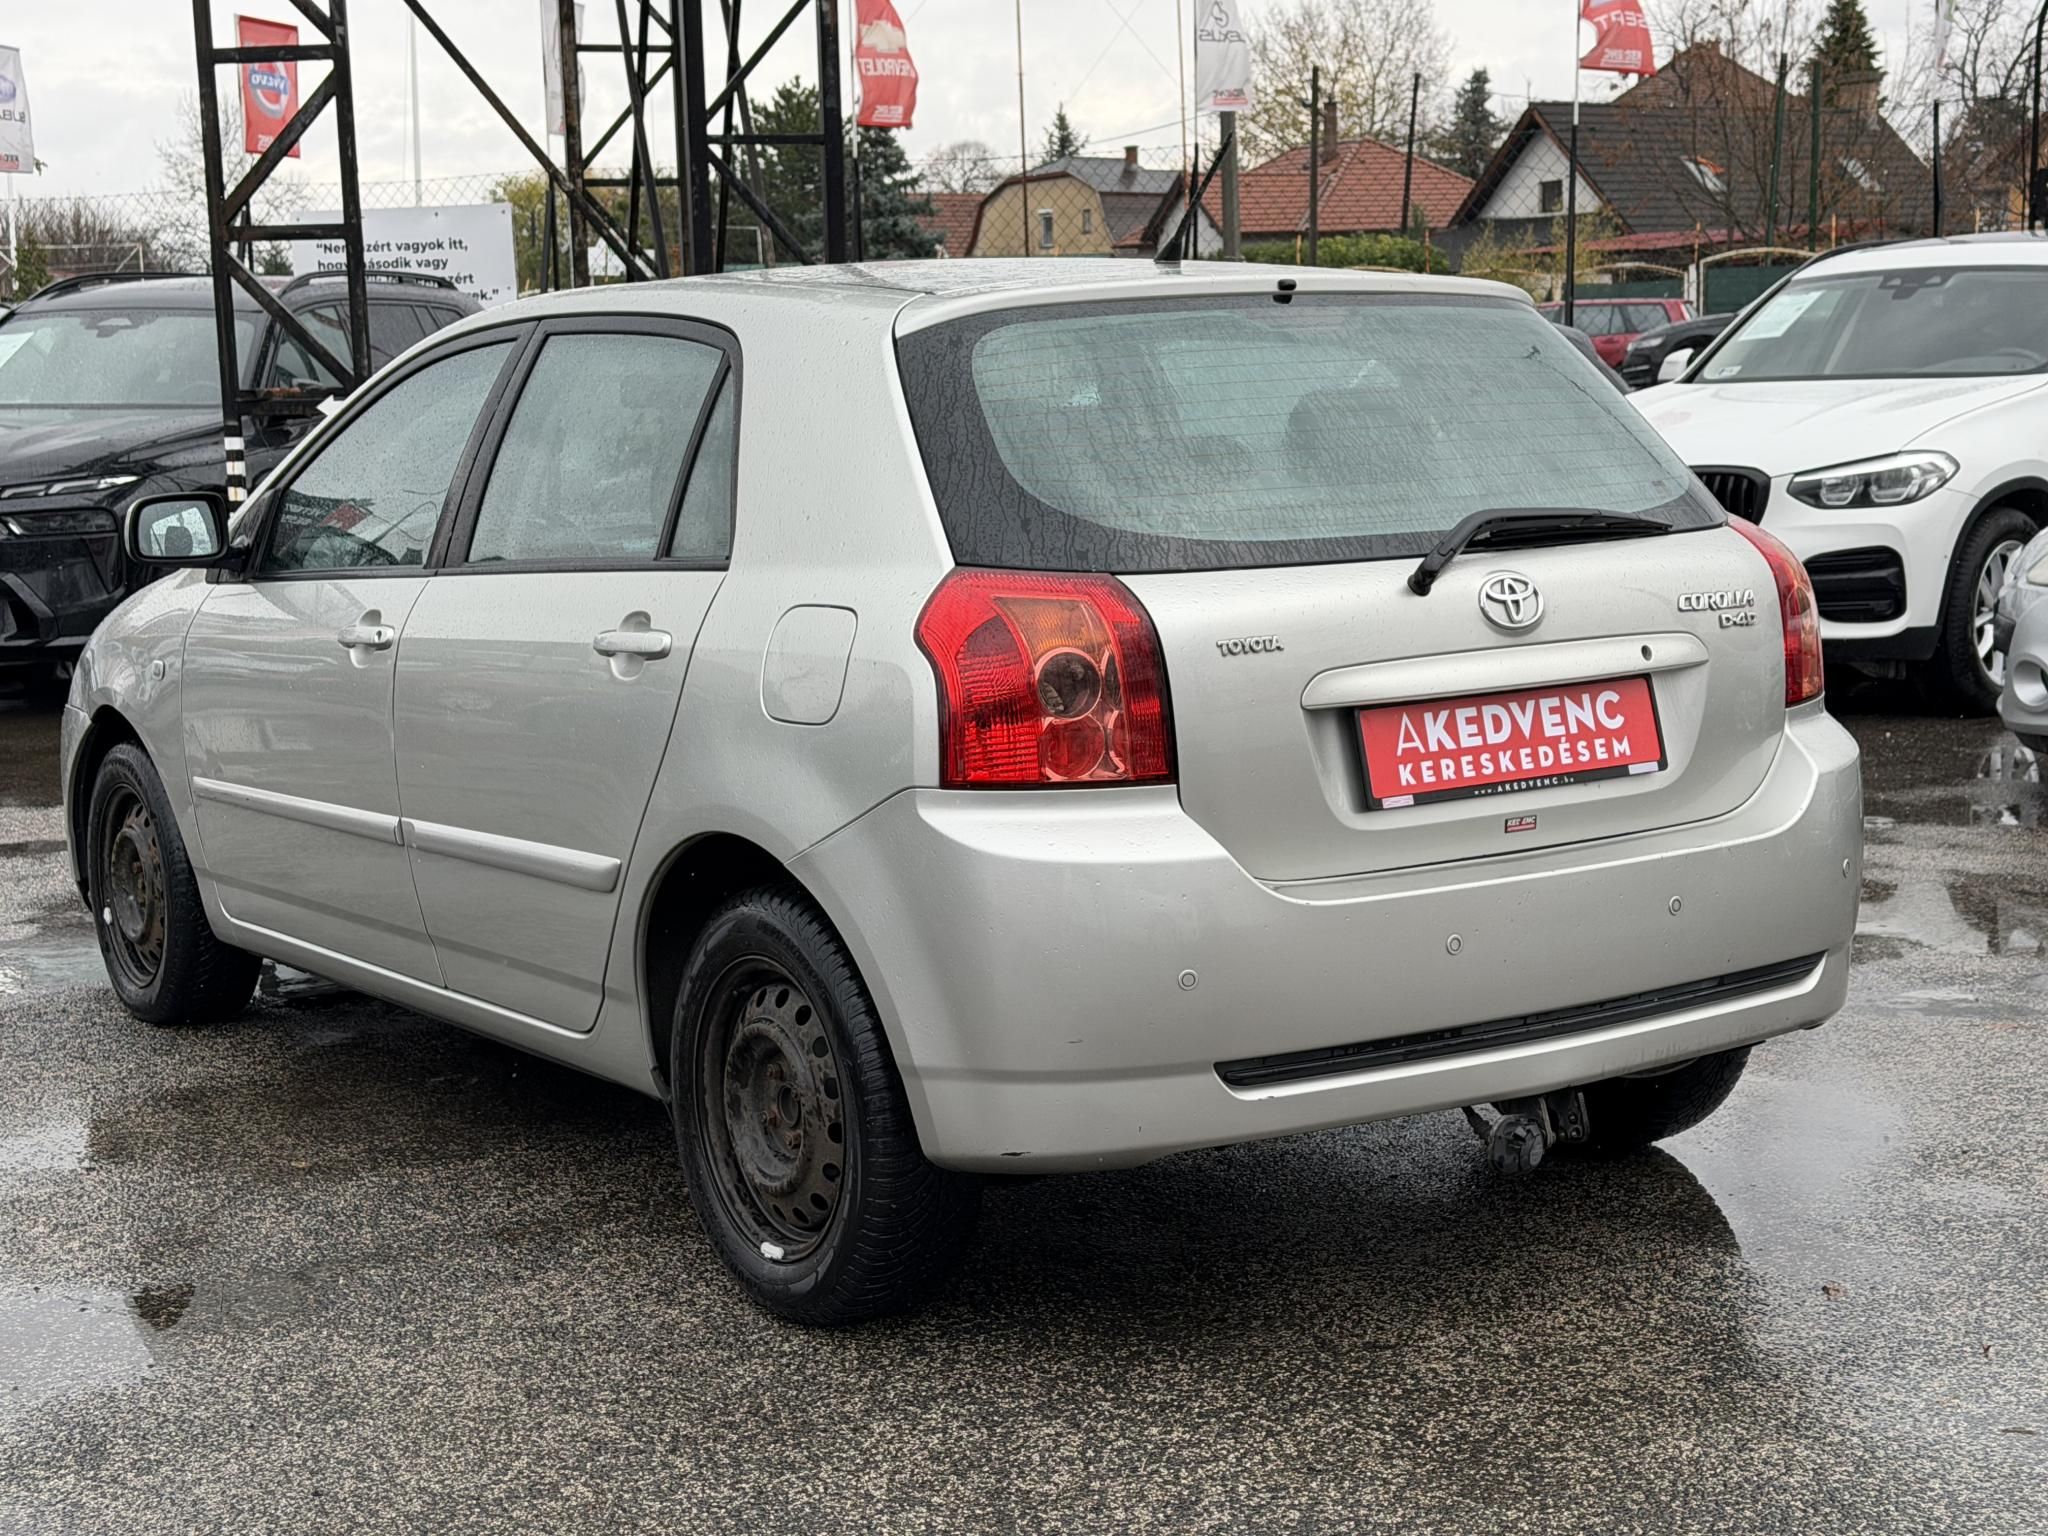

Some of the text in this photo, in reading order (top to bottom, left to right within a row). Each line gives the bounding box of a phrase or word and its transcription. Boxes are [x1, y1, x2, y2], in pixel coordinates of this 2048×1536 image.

[366, 240, 392, 252] zért
[395, 238, 445, 254] vagyok
[449, 236, 468, 252] itt,
[364, 256, 412, 269] ásodik
[416, 258, 449, 271] vagy
[1677, 589, 1755, 612] COROLLA
[1719, 611, 1759, 629] D-4D
[1216, 635, 1284, 657] TOYOTA
[1396, 690, 1625, 757] AKEDVENC
[1398, 735, 1631, 787] KERESKEDÉSEM
